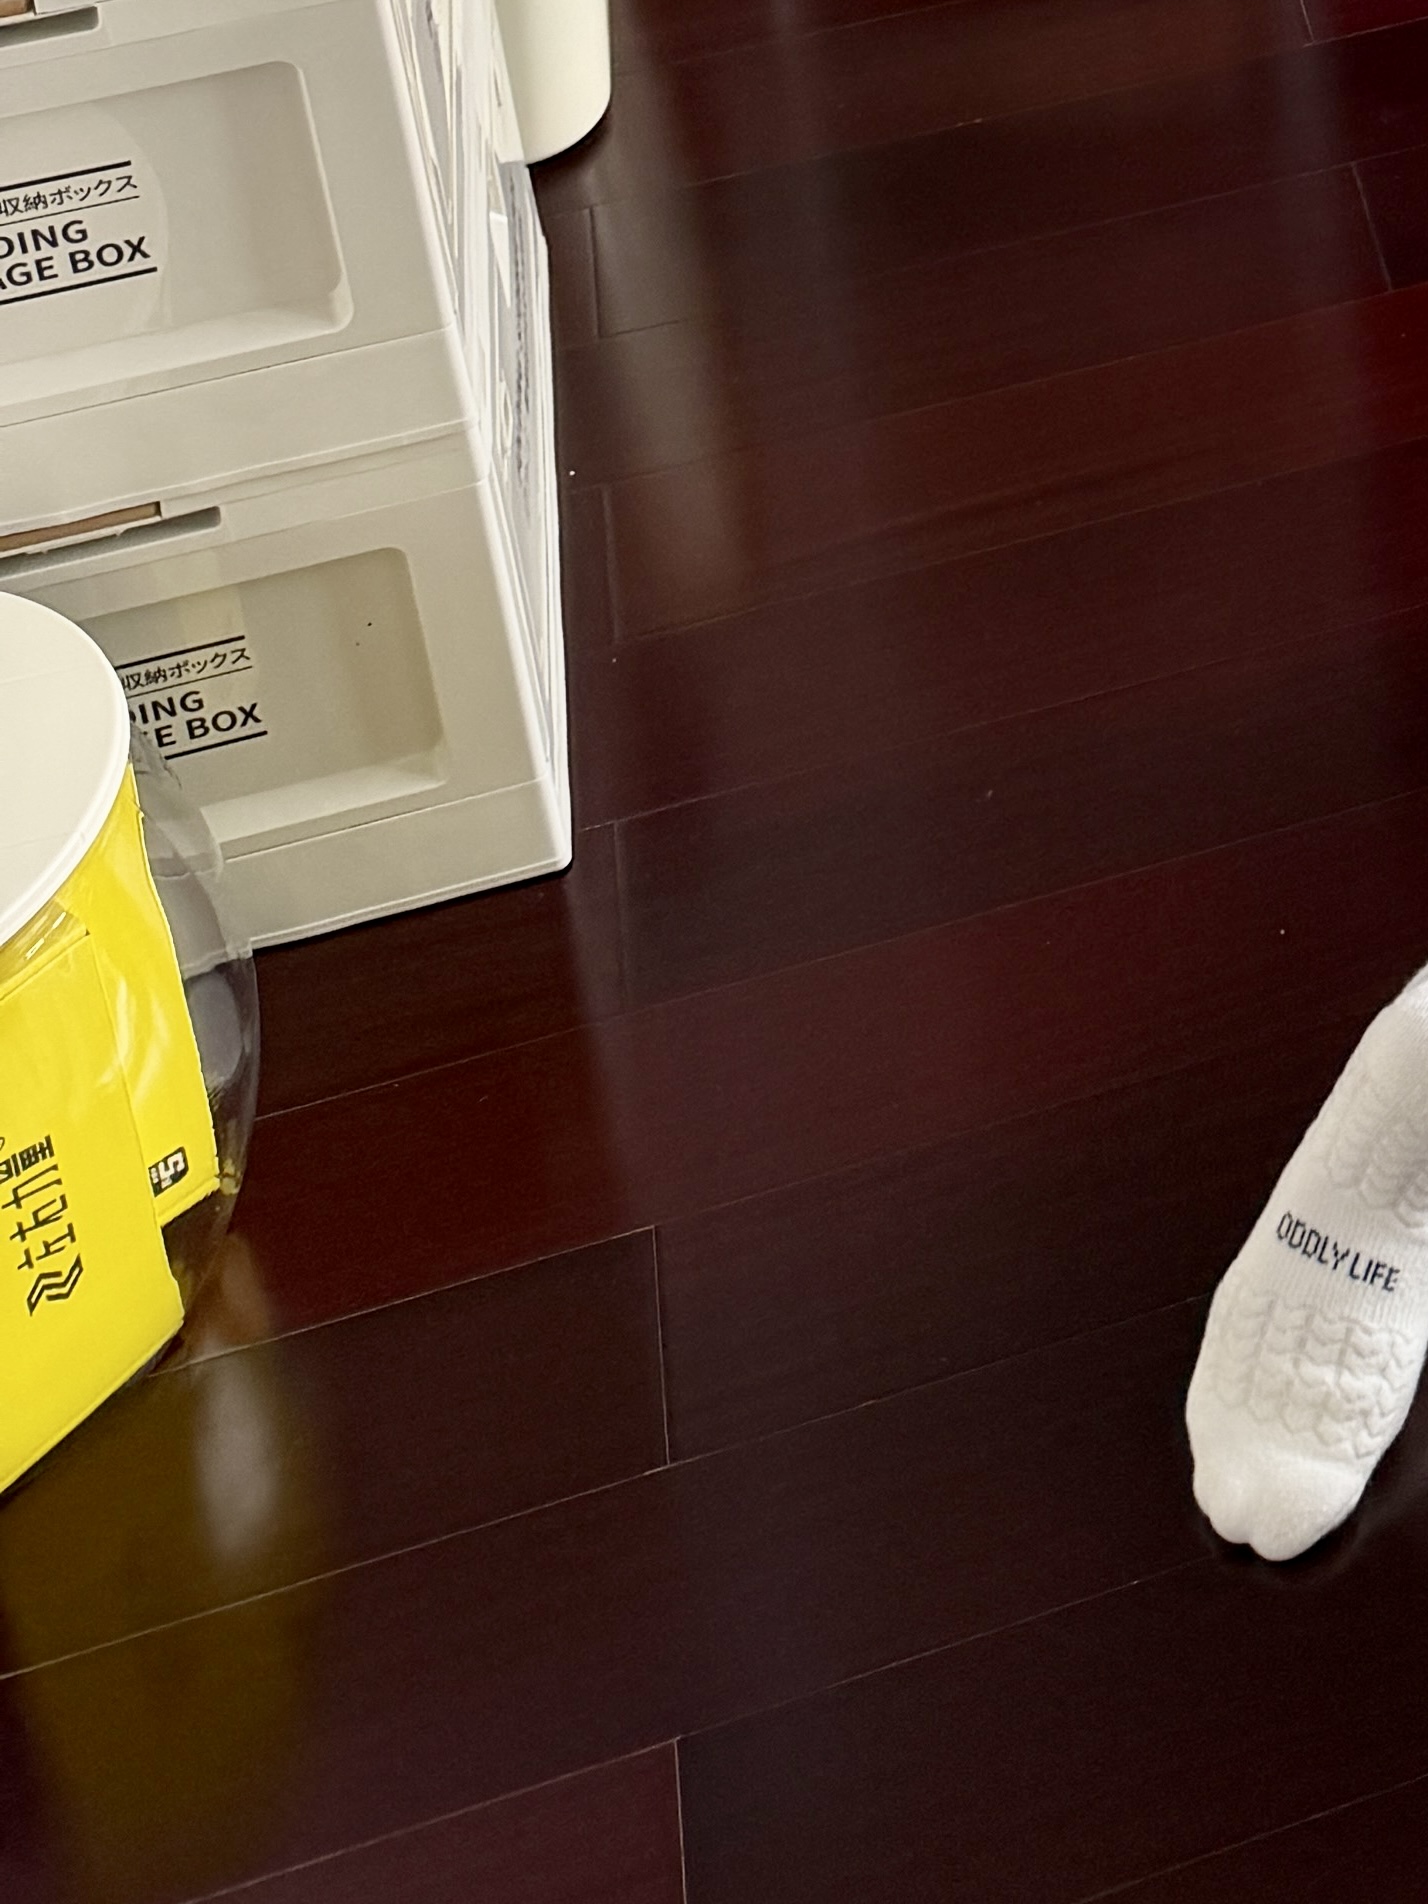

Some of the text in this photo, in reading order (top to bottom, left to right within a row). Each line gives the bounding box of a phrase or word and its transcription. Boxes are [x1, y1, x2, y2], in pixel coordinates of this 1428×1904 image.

[69, 236, 151, 274] BOX
[186, 703, 262, 740] BOX
[1276, 1210, 1400, 1293] ODDLY LIFE
